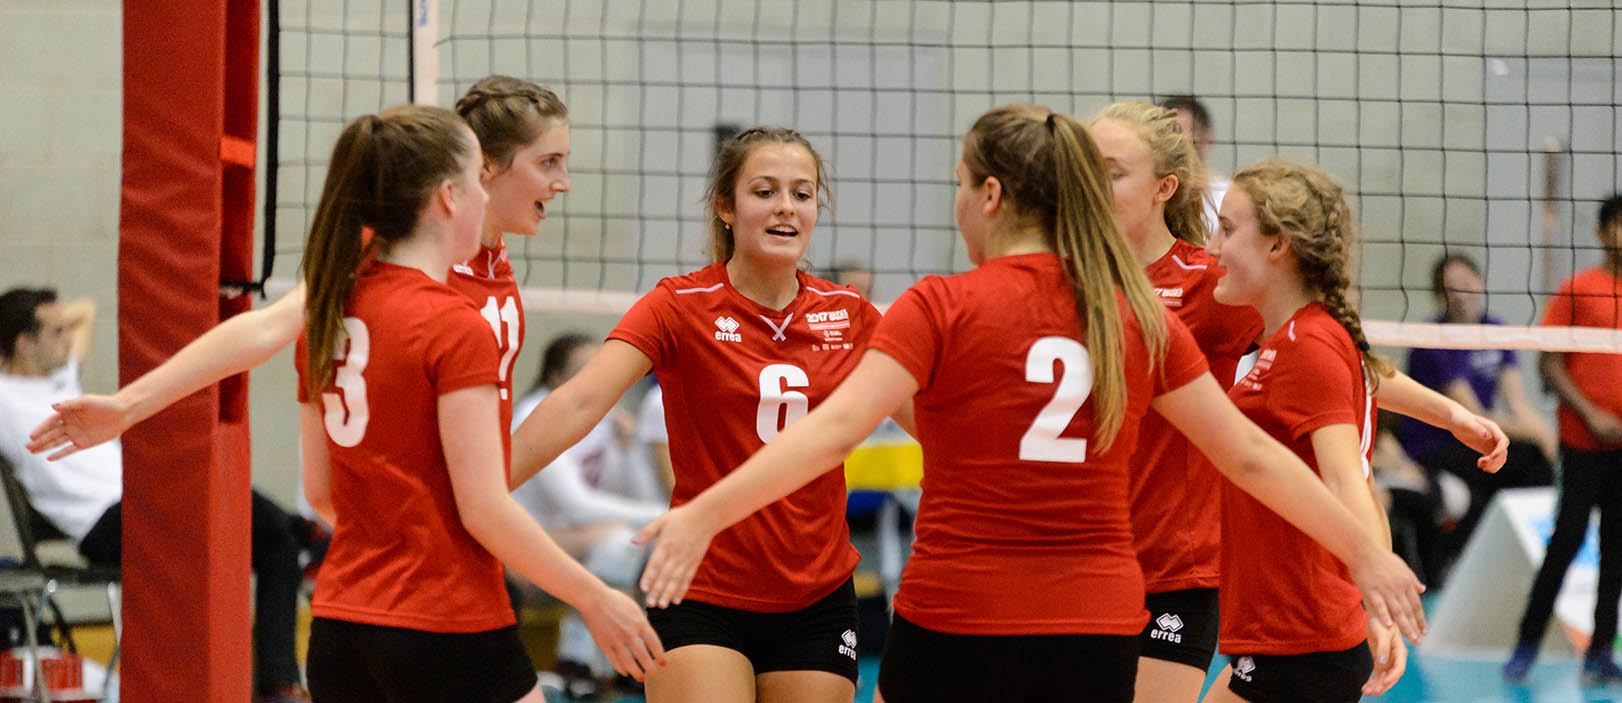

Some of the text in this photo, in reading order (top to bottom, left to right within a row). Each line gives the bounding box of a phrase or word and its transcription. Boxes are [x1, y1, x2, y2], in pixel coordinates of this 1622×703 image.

[715, 331, 742, 343] errea
[321, 317, 370, 448] 3
[756, 364, 809, 446] 6
[1019, 336, 1094, 463] 2
[1150, 629, 1181, 643] errea
